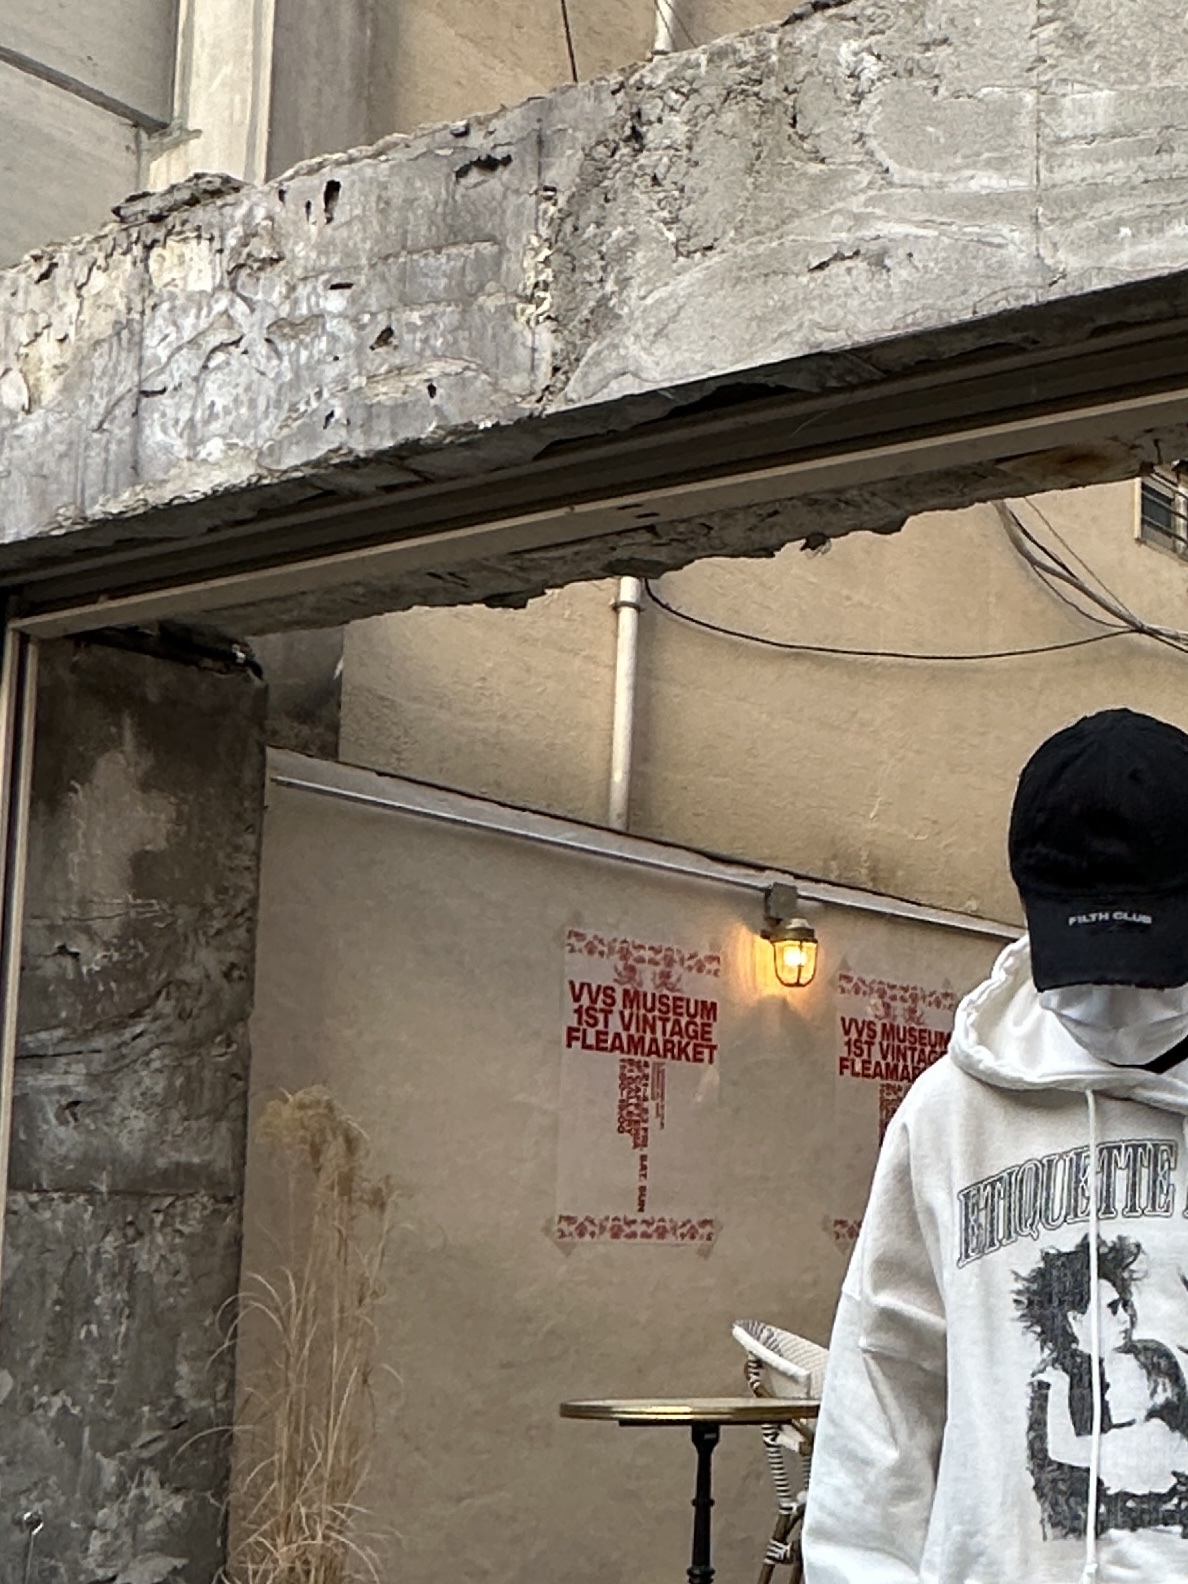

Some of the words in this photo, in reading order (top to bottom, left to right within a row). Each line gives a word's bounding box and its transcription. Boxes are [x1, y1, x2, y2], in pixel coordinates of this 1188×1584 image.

[1068, 912, 1109, 926] FILTH
[1112, 911, 1152, 924] CLUB
[568, 980, 616, 1007] VVS
[622, 988, 718, 1022] MUSEUM
[574, 1004, 613, 1029] 1ST
[619, 1010, 713, 1042] VINTAGE
[840, 1016, 877, 1040] VVS
[566, 1026, 718, 1065] FLEAMARKET
[844, 1037, 875, 1058] 1ST
[879, 1041, 948, 1066] VINTAG
[957, 1138, 1178, 1269] ETIQUETTE
